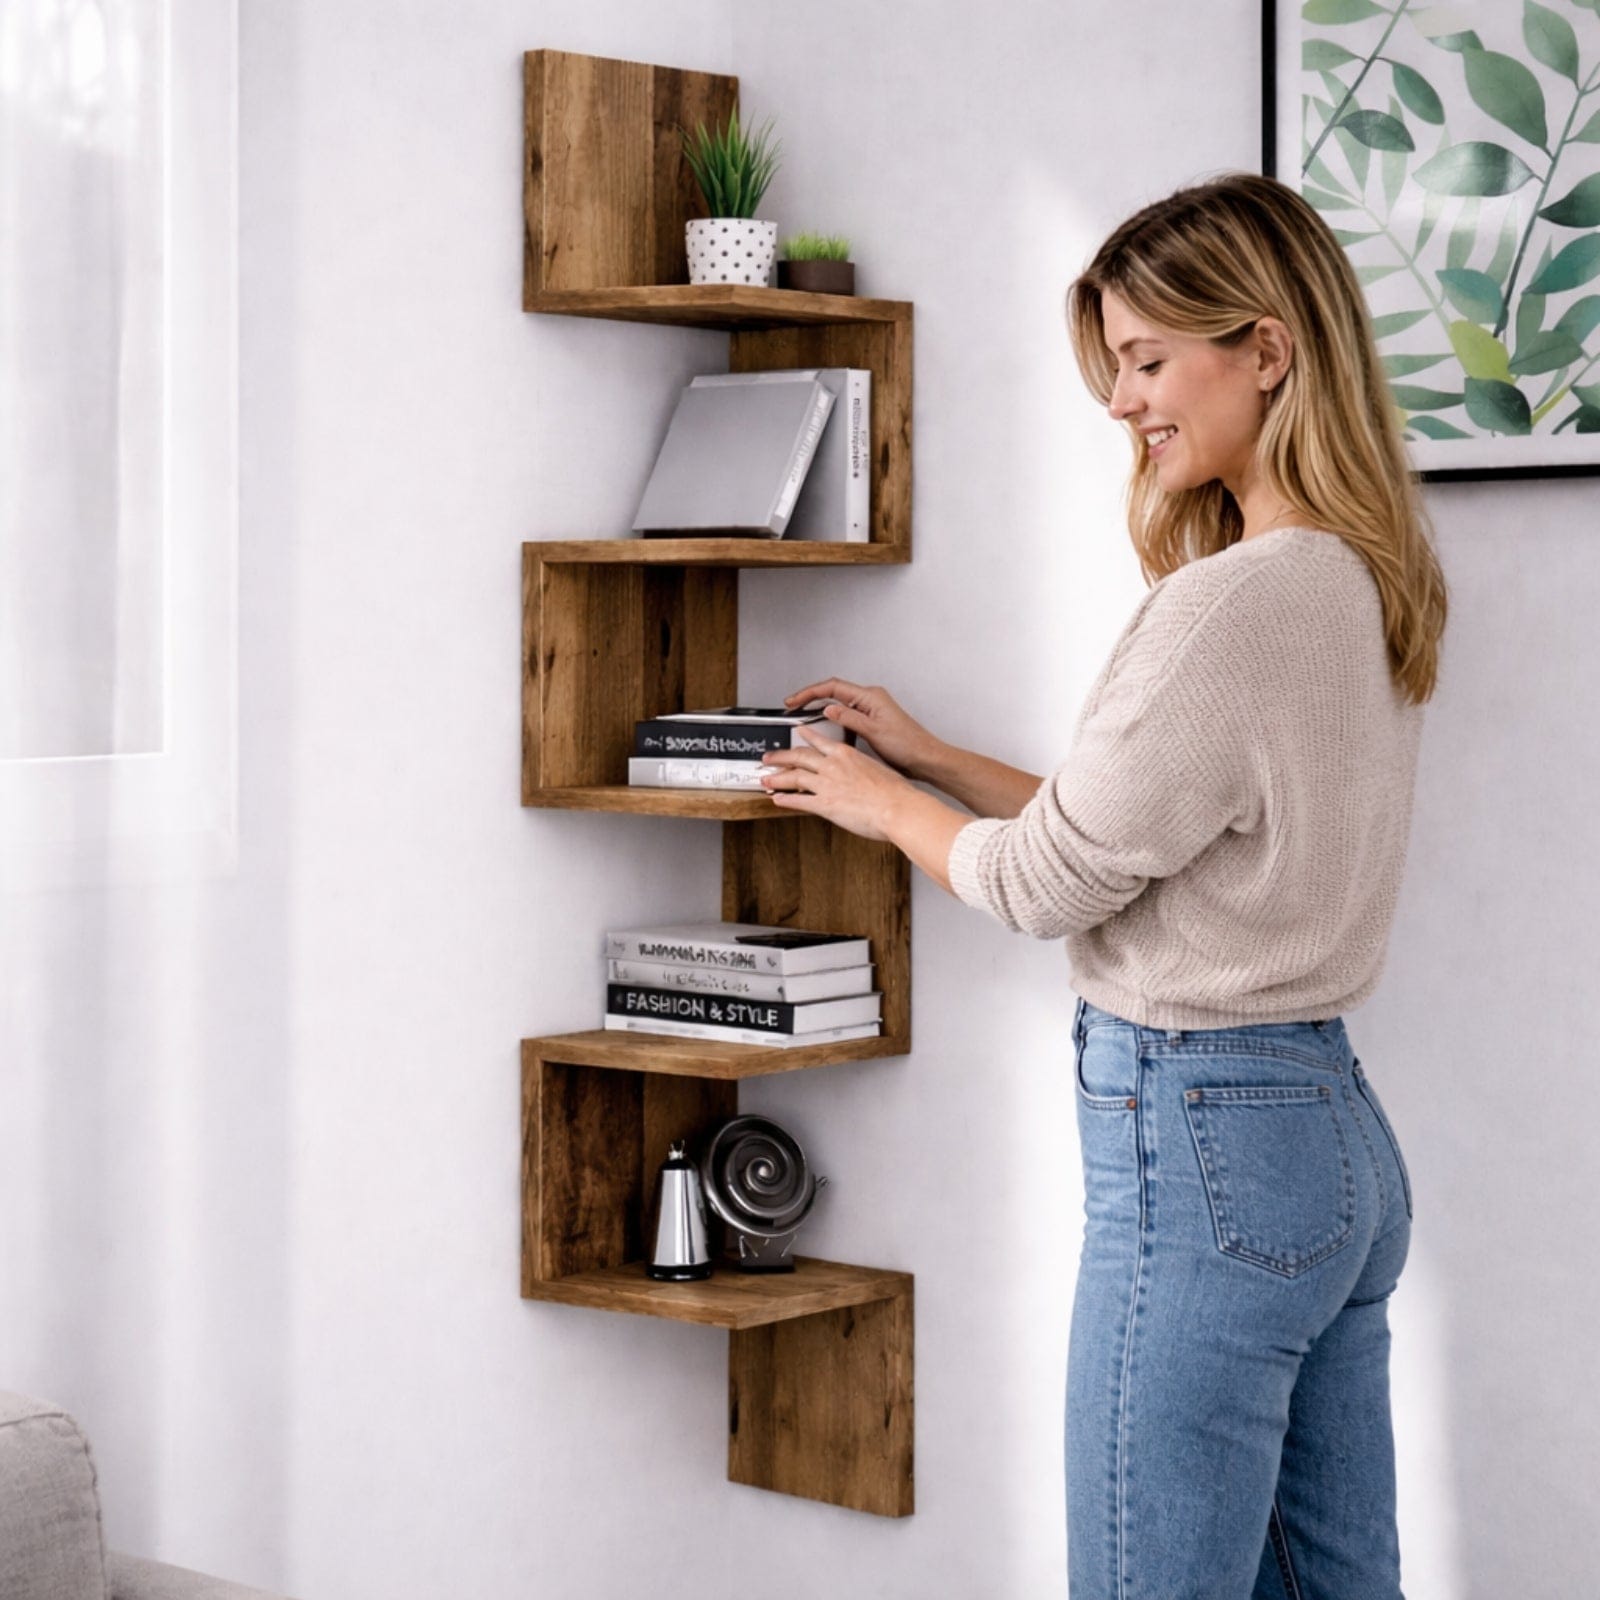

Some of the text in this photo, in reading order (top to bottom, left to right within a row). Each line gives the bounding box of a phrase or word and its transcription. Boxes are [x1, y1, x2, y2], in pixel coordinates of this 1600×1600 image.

[626, 992, 778, 1026] FASHION & STYLE
